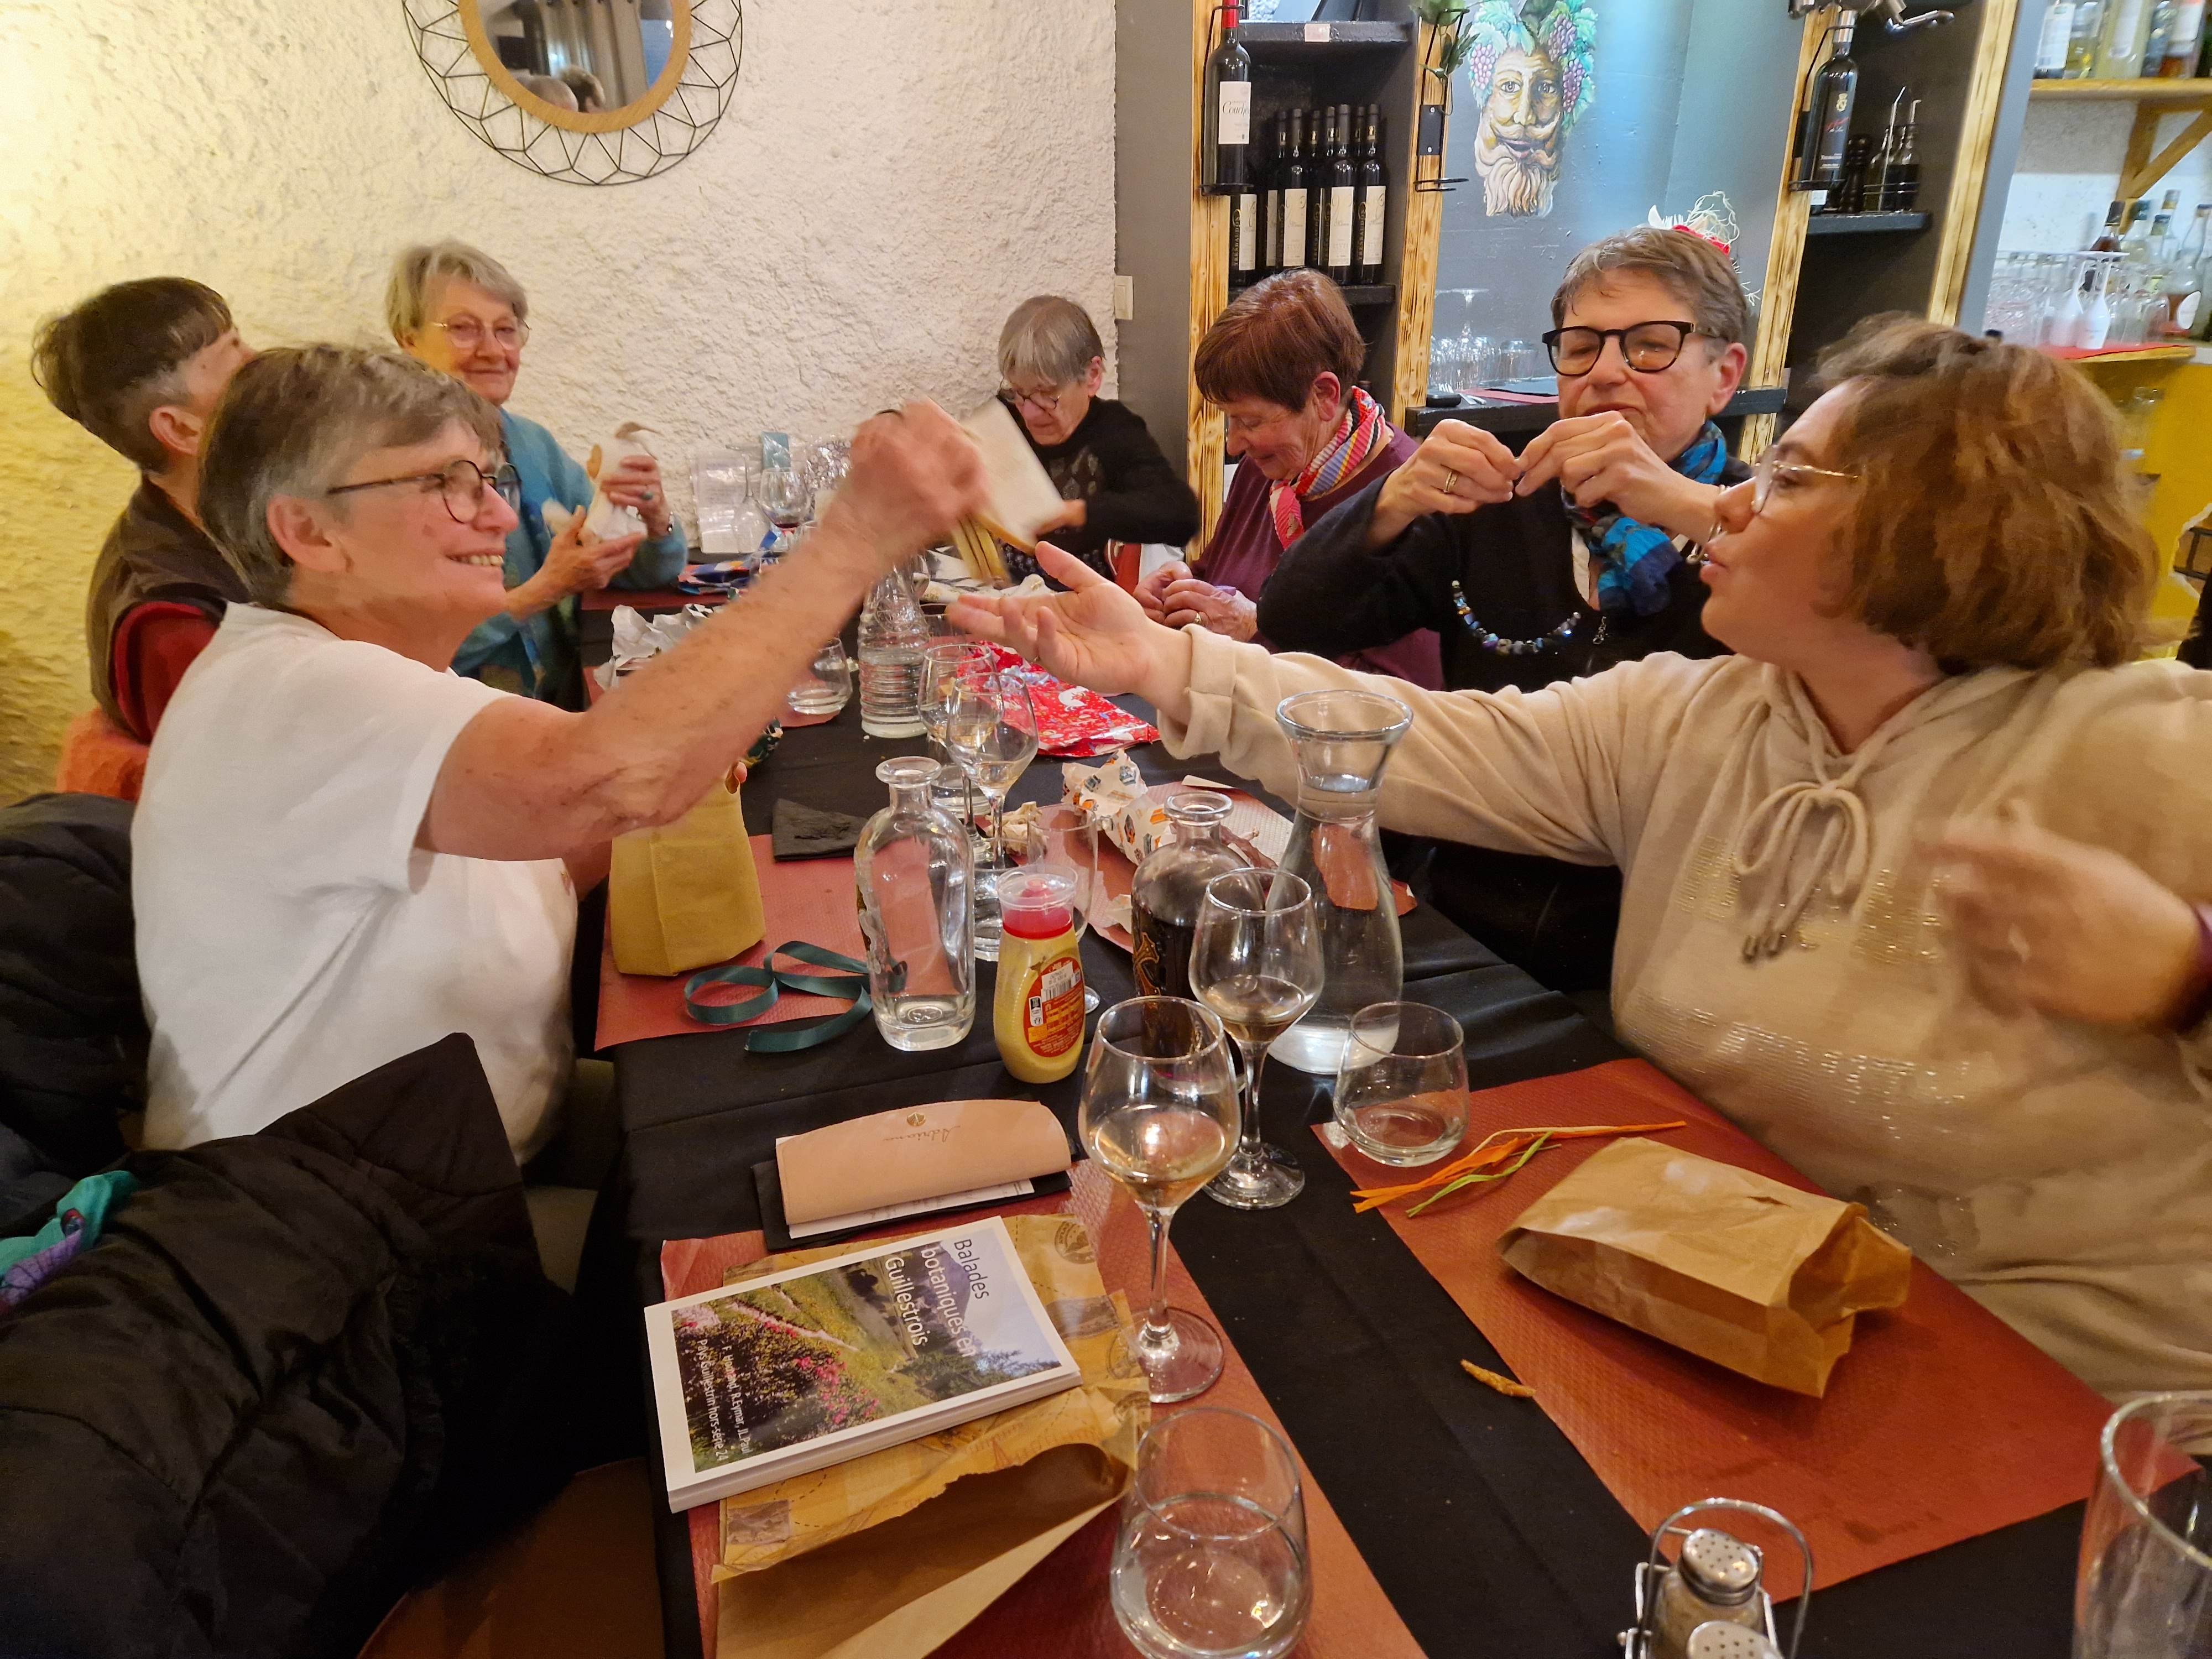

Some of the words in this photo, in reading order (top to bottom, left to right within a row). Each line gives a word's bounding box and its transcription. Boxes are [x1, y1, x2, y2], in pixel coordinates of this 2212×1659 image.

[953, 1239, 990, 1300] Balades
[885, 1257, 931, 1346] Guillestrois
[920, 1246, 967, 1335] botaniques
[956, 1337, 977, 1357] en
[696, 1339, 708, 1360] Pays
[700, 1361, 716, 1406] Guillestrin
[708, 1406, 725, 1449] hors-série
[715, 1449, 729, 1461] 24
